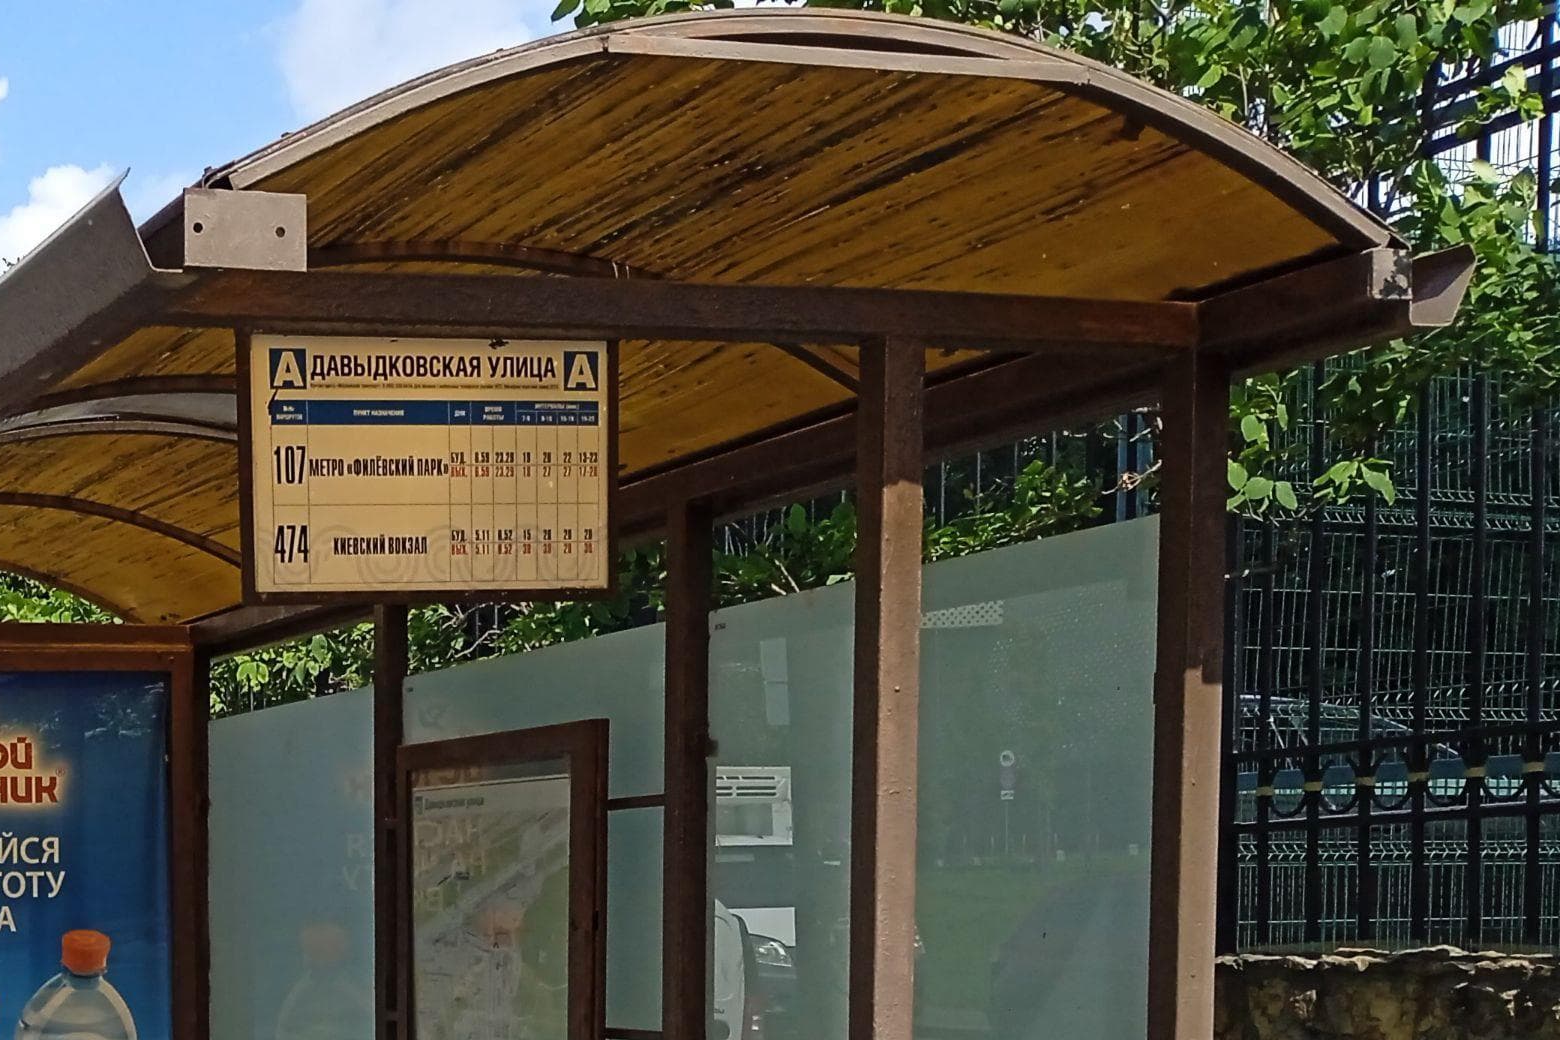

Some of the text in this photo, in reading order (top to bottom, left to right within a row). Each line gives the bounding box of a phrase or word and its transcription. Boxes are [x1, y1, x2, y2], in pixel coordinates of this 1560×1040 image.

[273, 351, 304, 387] А
[310, 354, 556, 382] ДАВЫДКОВСКАЯ УЛИЦА
[567, 354, 596, 388] А
[274, 445, 306, 484] 107
[309, 455, 449, 477] МЕТРО «ФИЛЁВСКИЙ ПАРК»
[274, 525, 309, 563] 474
[333, 534, 428, 555] КИЕВСКИЙ ВОКЗАЛ
[475, 530, 490, 541] 5.11
[475, 544, 490, 555] 5.11
